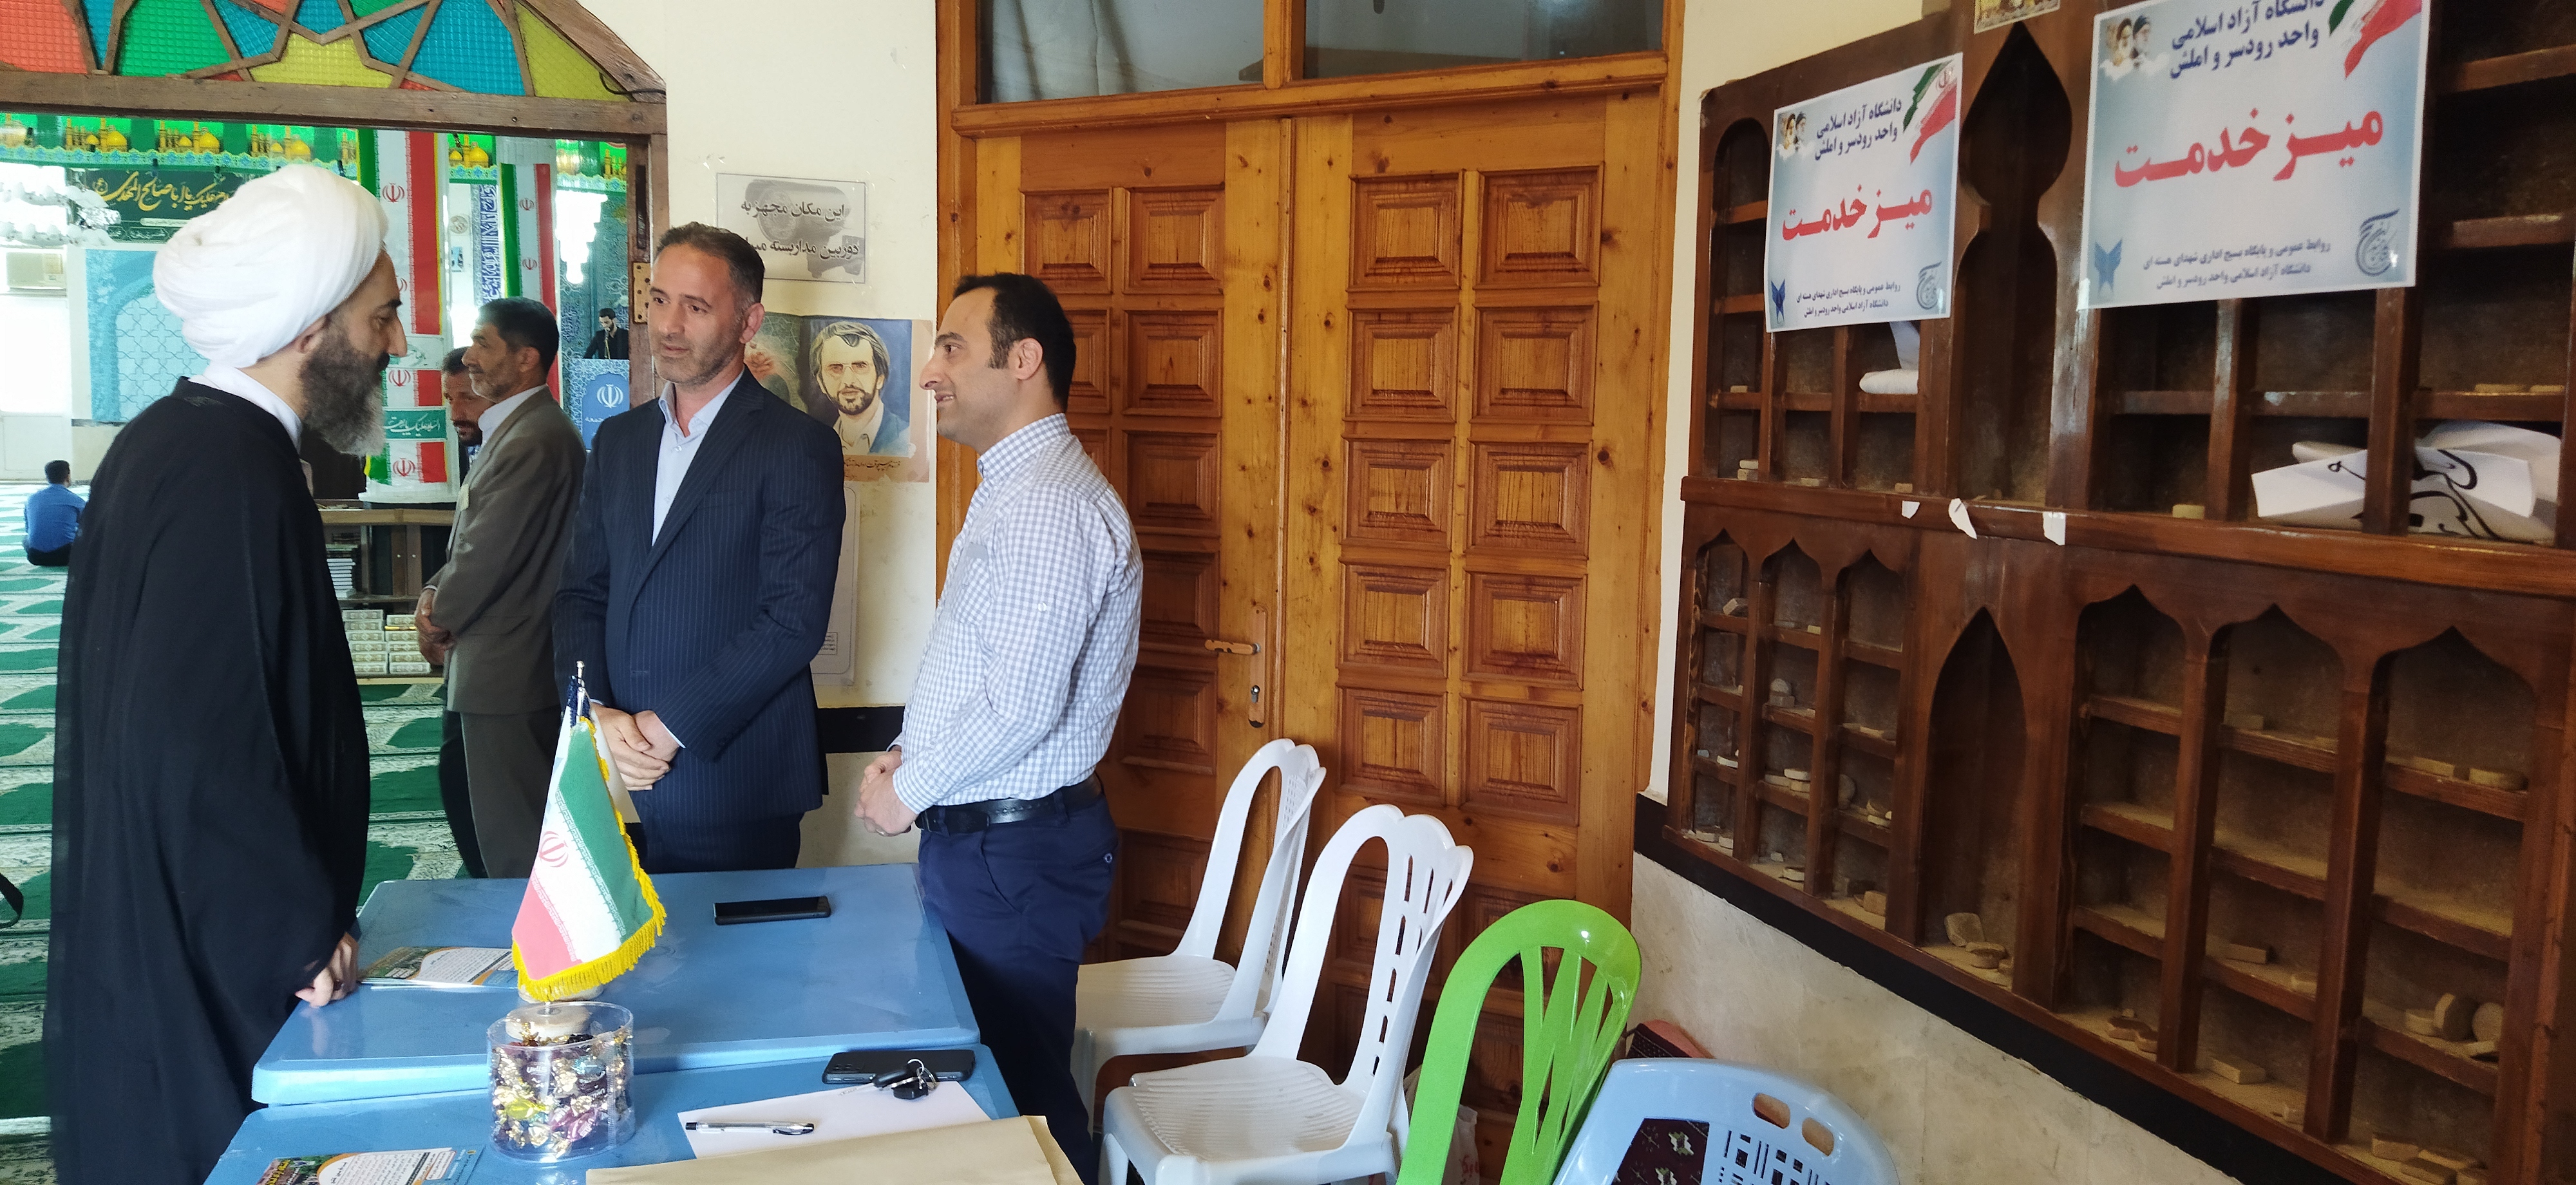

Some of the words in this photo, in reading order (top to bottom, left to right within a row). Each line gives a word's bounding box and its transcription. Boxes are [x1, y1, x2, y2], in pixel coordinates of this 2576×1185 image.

[2227, 0, 2261, 34] آزاد
[2172, 12, 2223, 50] اسلامی
[2278, 19, 2319, 48] واحد
[2170, 45, 2208, 79] املش
[2211, 52, 2220, 70] و
[2224, 39, 2273, 68] رودسر
[1847, 104, 1867, 129] آزاد
[1869, 98, 1902, 119] دانشگاه
[1817, 113, 1846, 138] اسلامی
[1875, 121, 1897, 142] واحد
[1815, 136, 1837, 160] املش
[1838, 141, 1843, 156] و
[1844, 133, 1872, 154] رودسر
[2115, 108, 2271, 187] خدمت
[2273, 111, 2383, 182] میز
[741, 201, 752, 214] به
[753, 200, 788, 218] مجهز
[791, 202, 822, 217] مکان
[825, 204, 844, 222] این
[1782, 184, 1867, 241] خدمت
[1868, 189, 1932, 238] میز
[820, 245, 859, 260] دوربین
[2276, 243, 2303, 256] عمومی
[2306, 238, 2331, 252] روابط
[2208, 270, 2228, 284] واحد
[2230, 267, 2259, 283] اسلامی
[2260, 263, 2278, 281] آزاد
[2280, 262, 2311, 275] دانشگاه
[1867, 284, 1883, 294] عمومی
[1886, 281, 1900, 292] روابط
[2183, 274, 2207, 288] رودسر
[1817, 307, 1829, 317] رودسر
[1830, 304, 1841, 314] واحد
[1842, 301, 1857, 314] اسلامی
[1858, 299, 1868, 312] آزاد
[1870, 299, 1888, 308] دانشگاه
